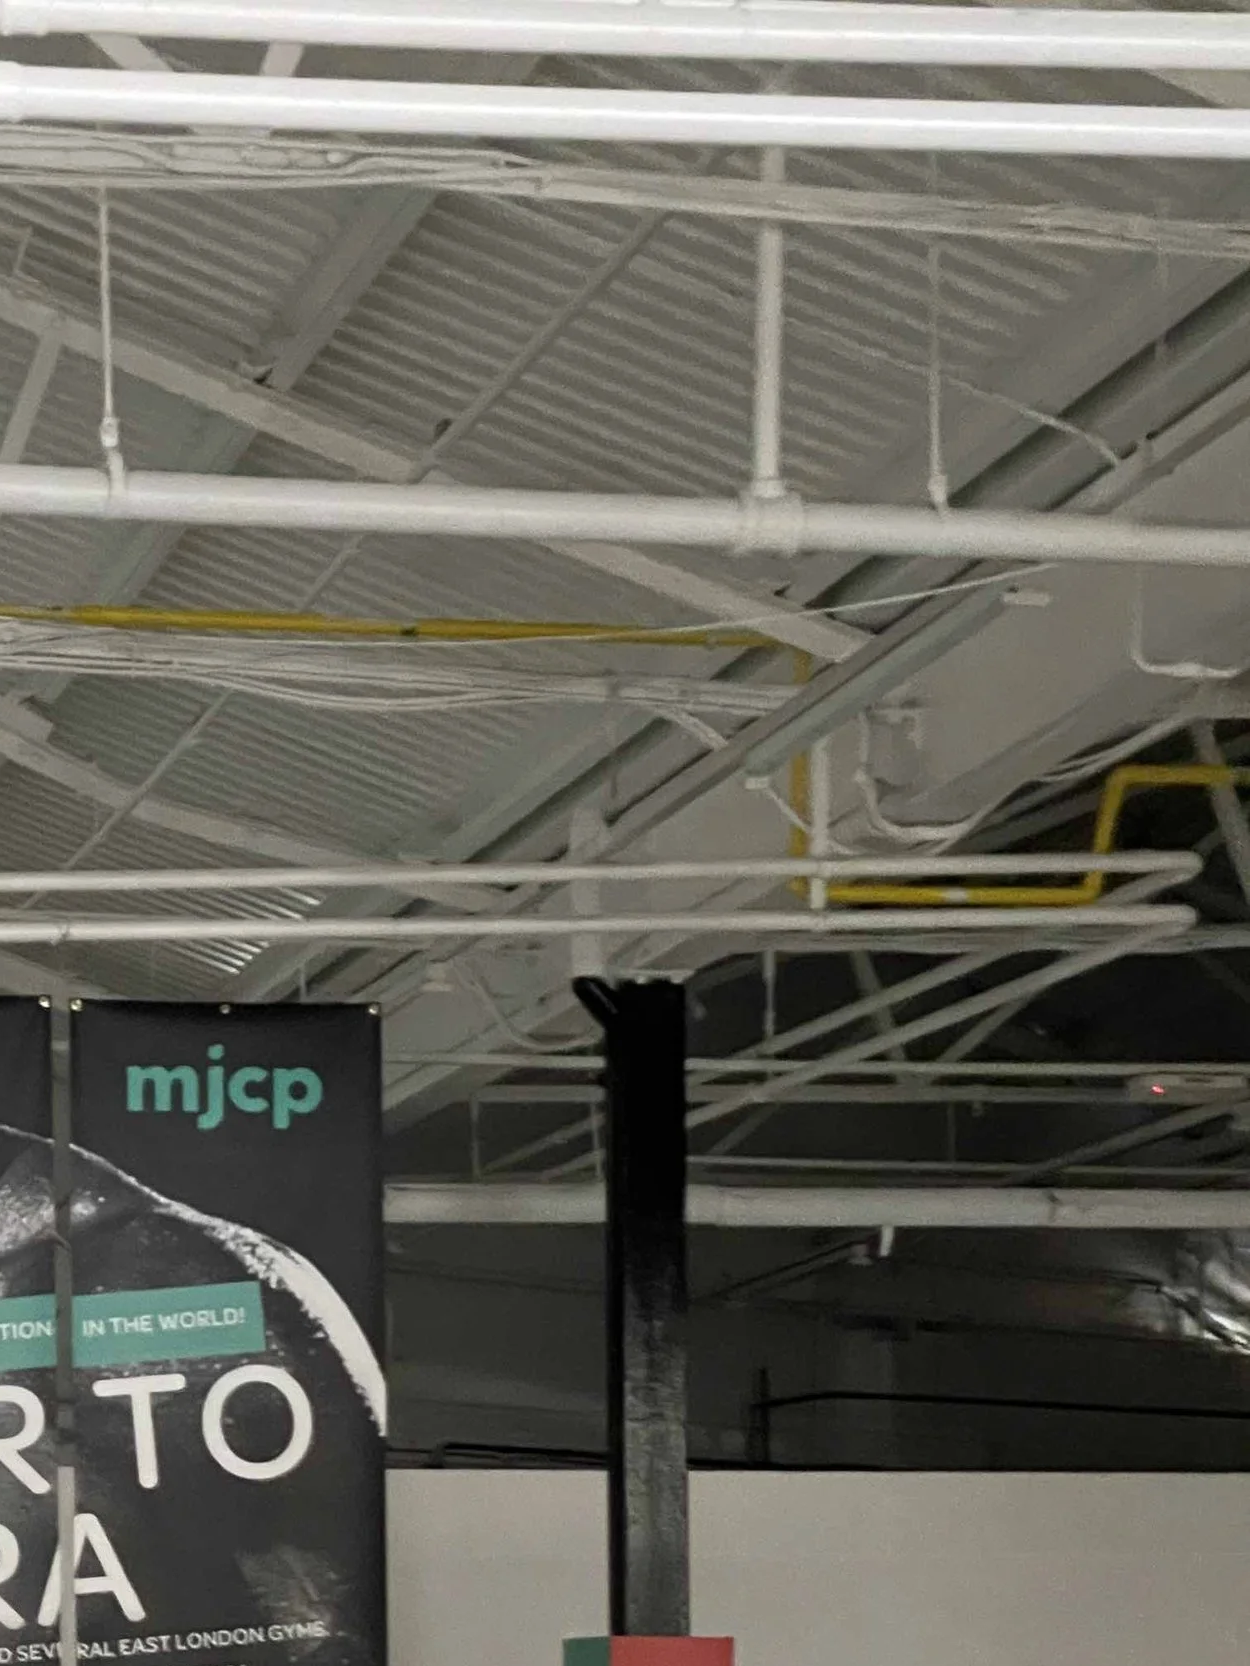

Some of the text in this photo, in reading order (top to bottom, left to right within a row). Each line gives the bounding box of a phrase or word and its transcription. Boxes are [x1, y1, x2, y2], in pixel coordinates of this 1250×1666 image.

[126, 1044, 323, 1129] mjcp
[82, 1318, 105, 1337] IN
[109, 1314, 154, 1333] THE
[158, 1307, 245, 1330] WORLD!
[93, 1364, 314, 1489] TO
[119, 1634, 171, 1655] EAST
[176, 1626, 266, 1650] LONDON
